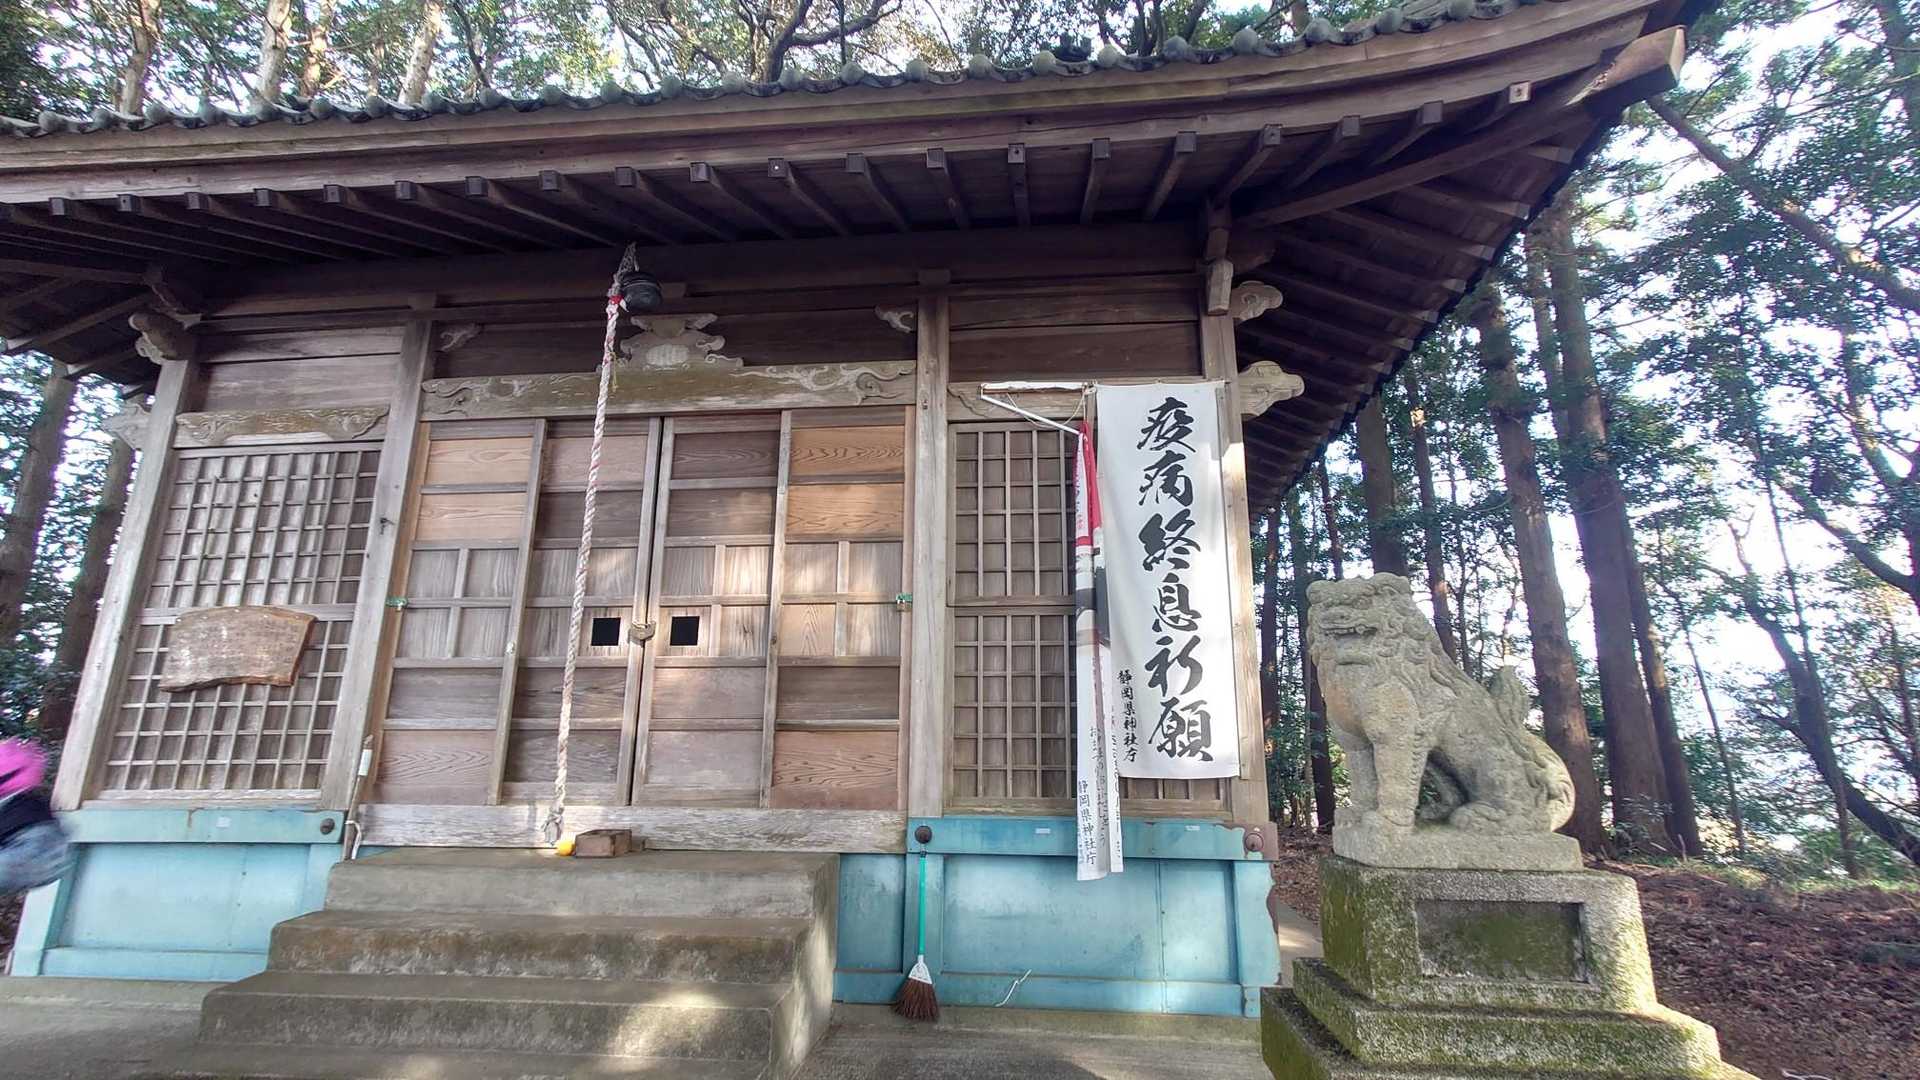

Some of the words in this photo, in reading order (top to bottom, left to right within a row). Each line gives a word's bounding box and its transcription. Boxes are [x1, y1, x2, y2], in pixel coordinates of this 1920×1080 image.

[1137, 397, 1214, 762] 疫病終息祈願
[1117, 668, 1139, 762] 静岡県神社庁
